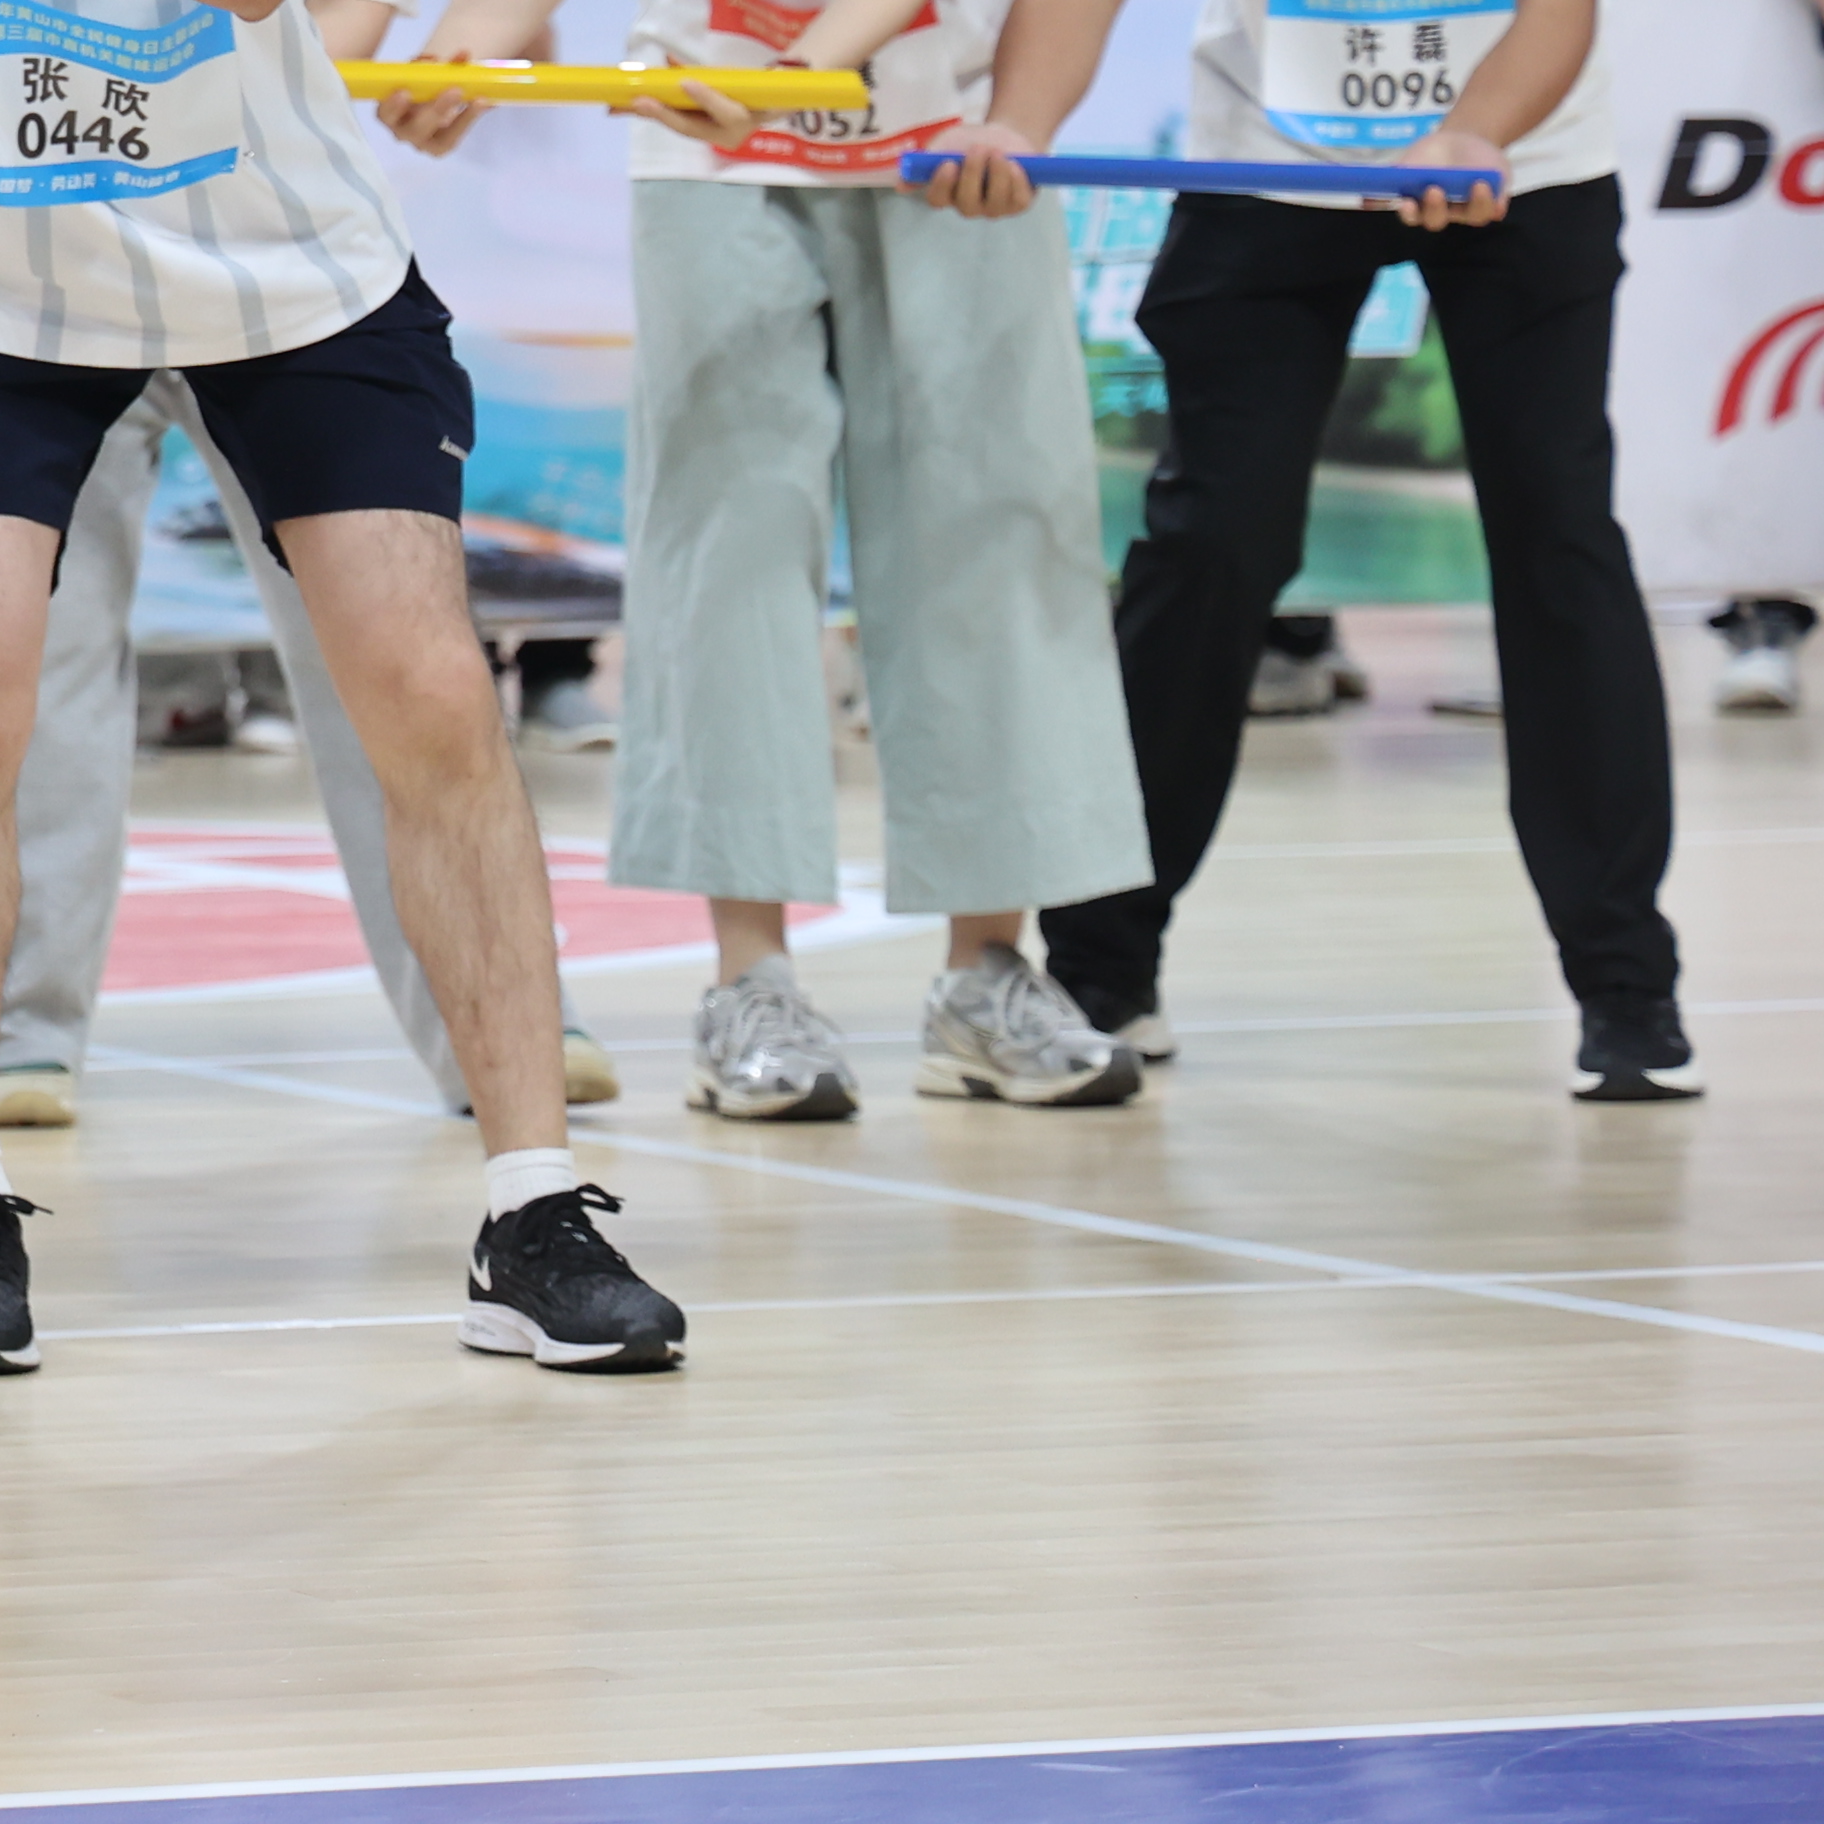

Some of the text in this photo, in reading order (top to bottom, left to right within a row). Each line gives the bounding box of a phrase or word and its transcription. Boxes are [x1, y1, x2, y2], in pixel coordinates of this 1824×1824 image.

[1342, 71, 1455, 109] 0096
[17, 110, 150, 161] 0446
[789, 102, 879, 138] 052
